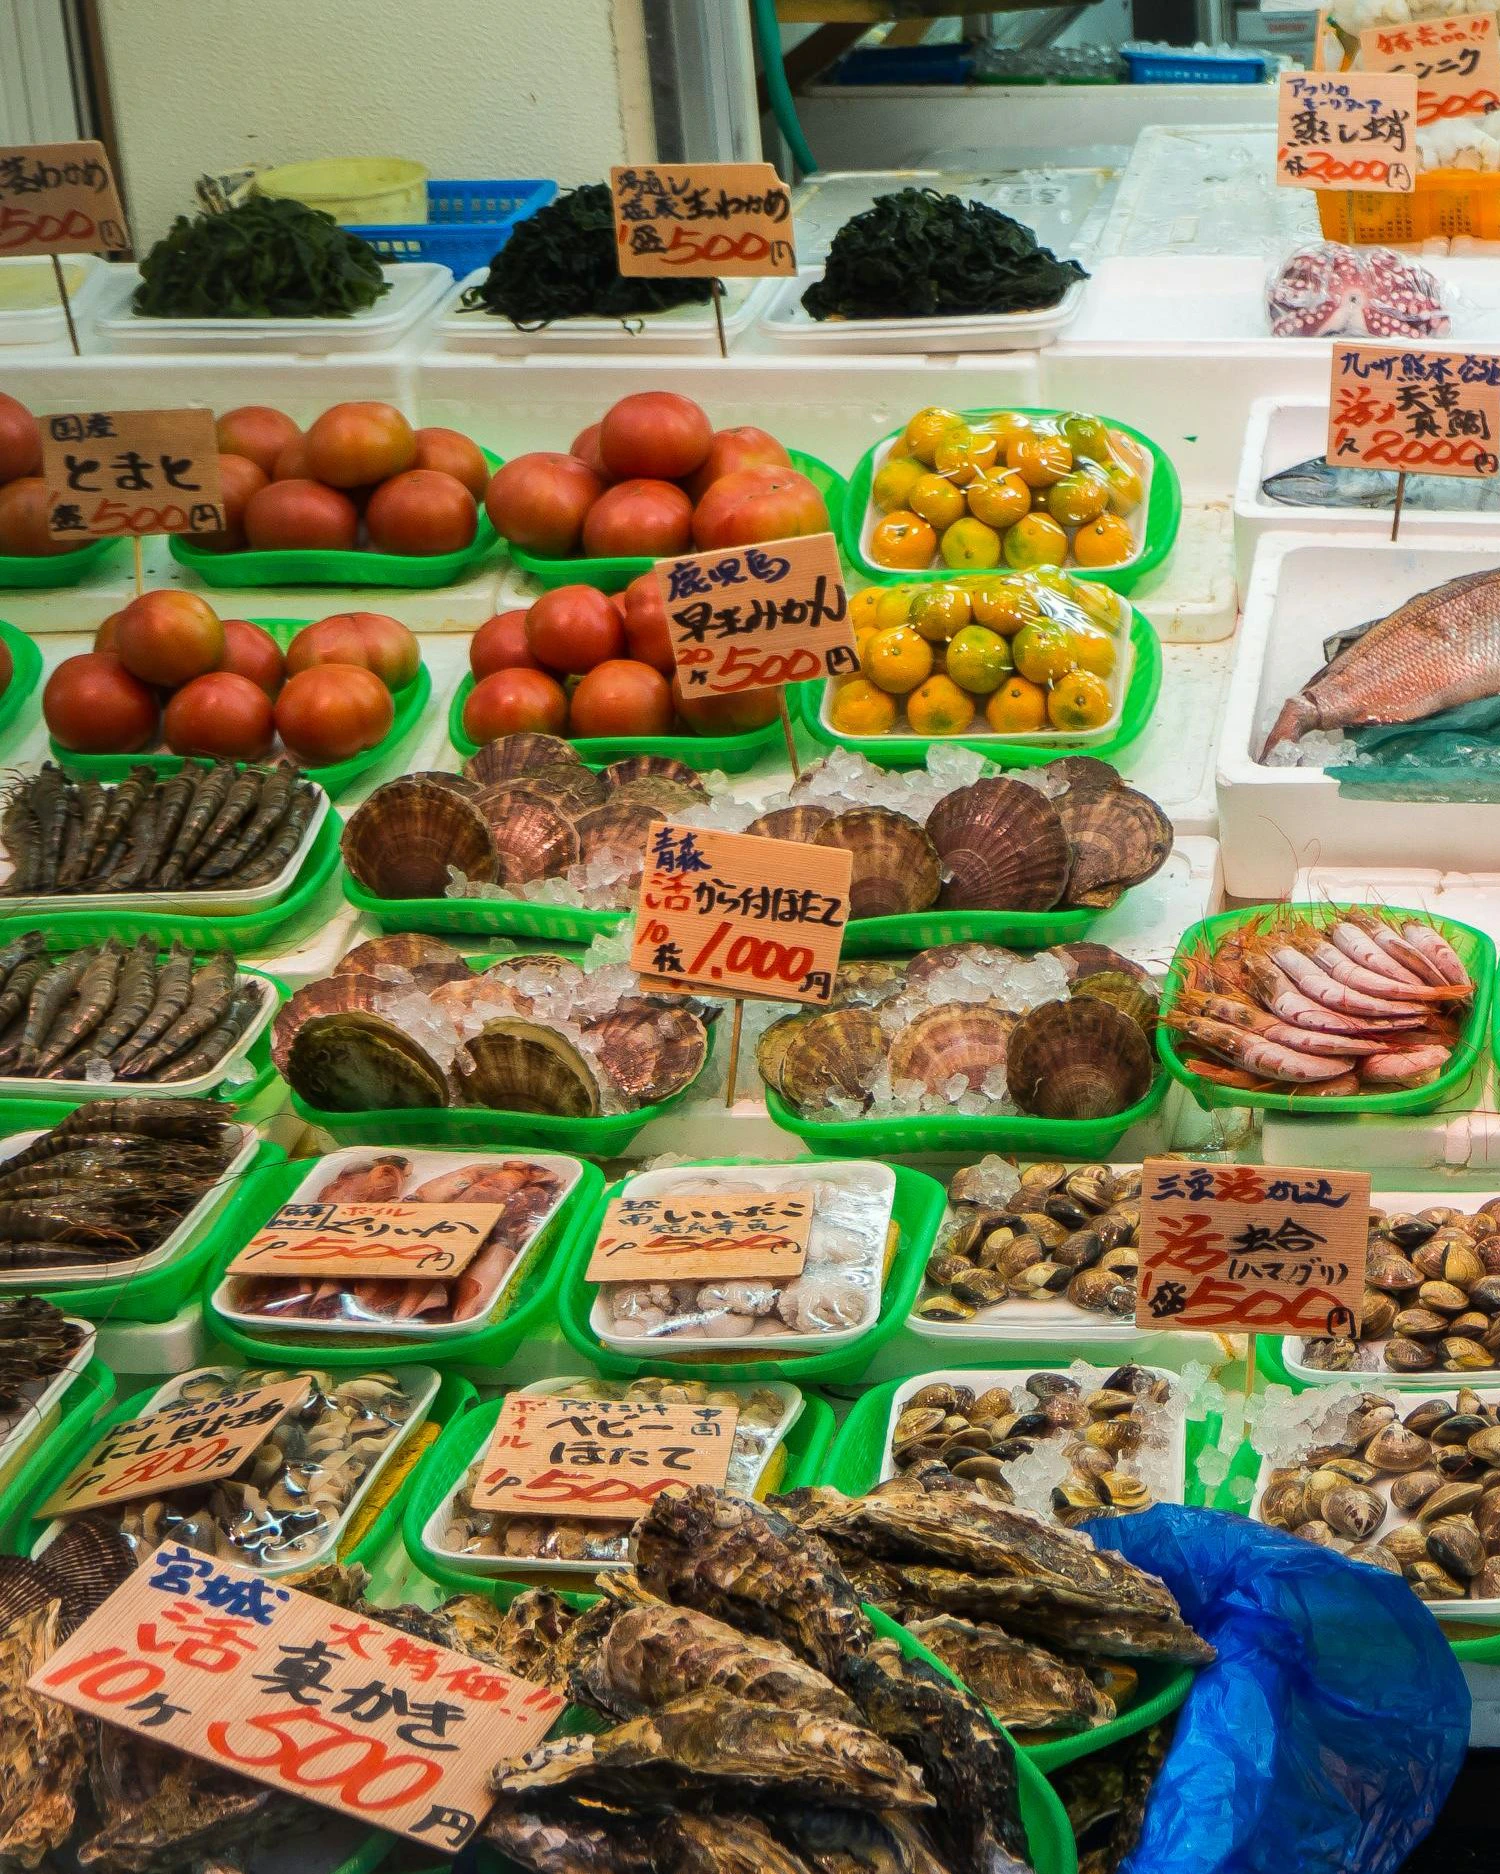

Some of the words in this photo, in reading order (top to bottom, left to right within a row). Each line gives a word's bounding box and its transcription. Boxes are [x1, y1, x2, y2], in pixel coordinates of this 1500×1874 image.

[50, 413, 117, 444] 国産
[64, 452, 202, 492] とまと
[667, 548, 791, 603] 鹿児島
[673, 575, 848, 643] 早生みかん
[652, 826, 713, 873] 青森
[1145, 1214, 1230, 1275] 活
[1228, 1258, 1349, 1286] (ハマグリ)
[499, 1400, 547, 1449] ボイル
[546, 1414, 674, 1438] ベビー
[549, 1441, 696, 1470] ほたて
[148, 1547, 290, 1625] 宮城
[138, 1601, 258, 1673] 活
[252, 1640, 467, 1750] 真かき
[329, 1620, 561, 1722] 大特価!!
